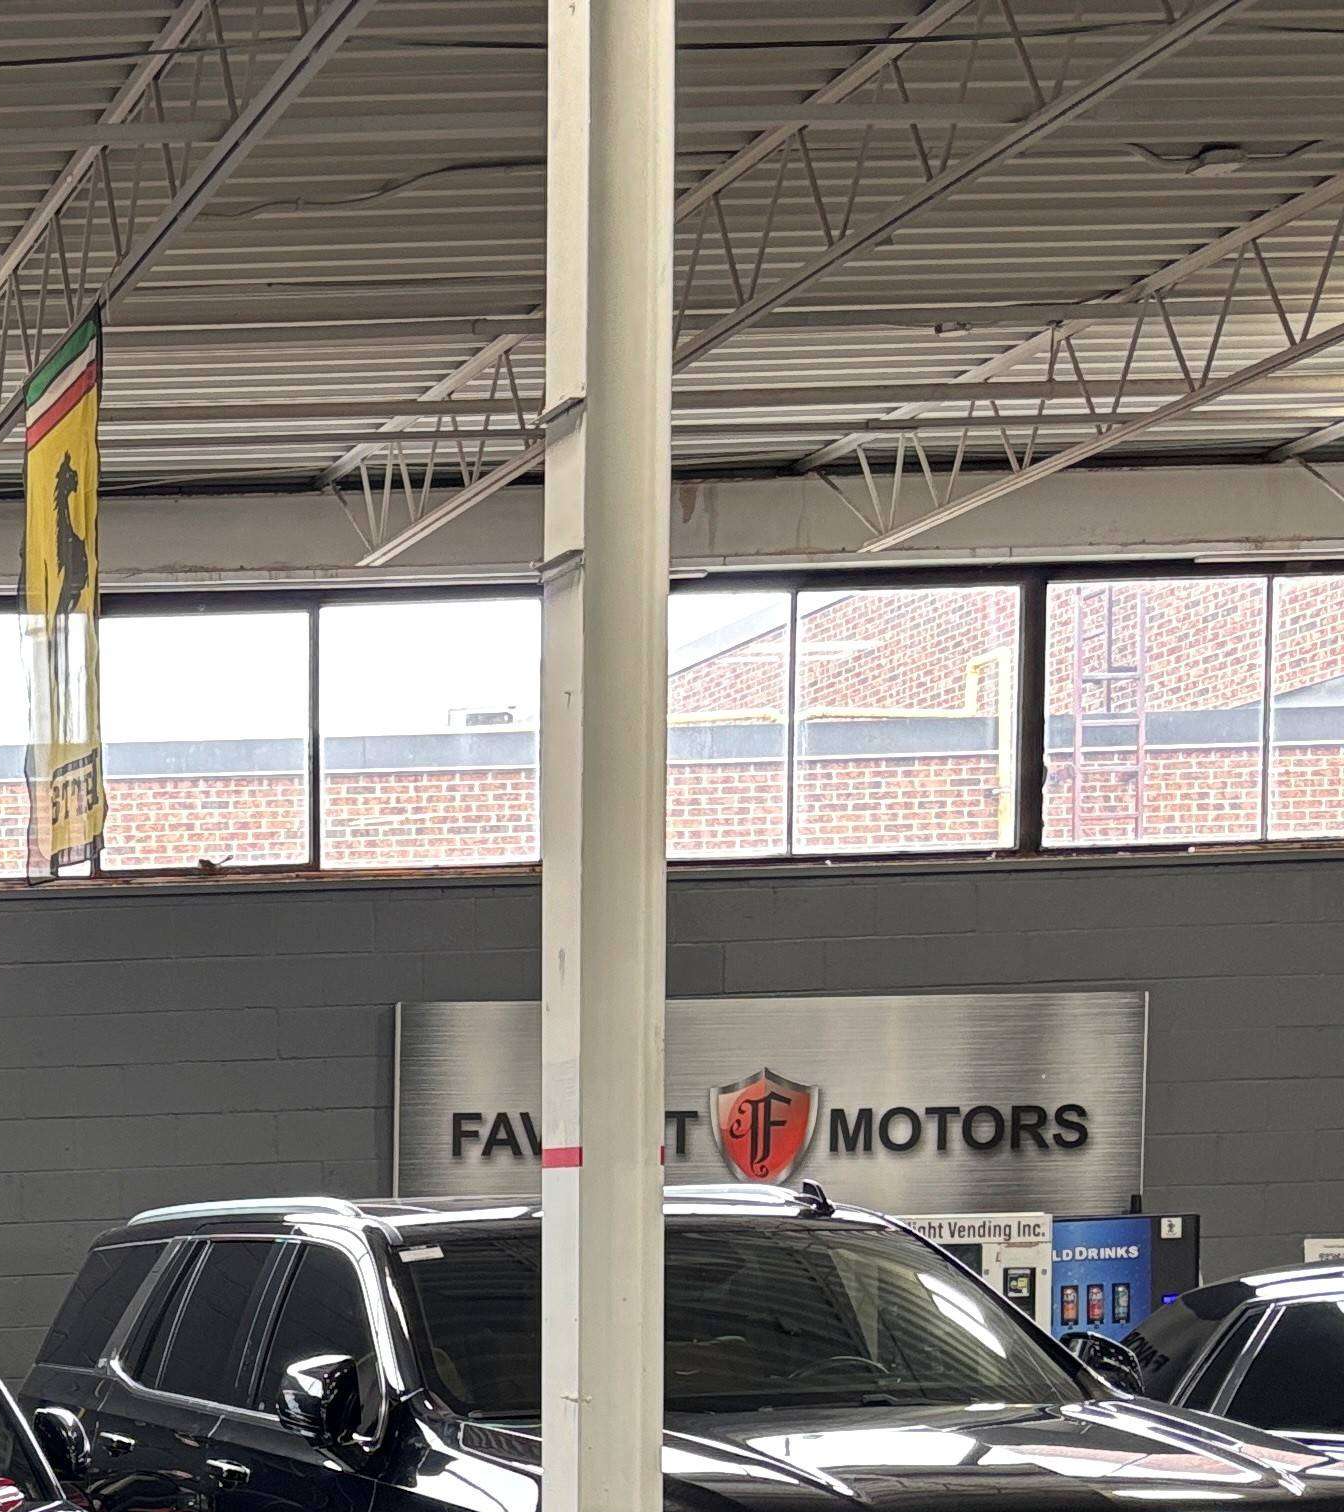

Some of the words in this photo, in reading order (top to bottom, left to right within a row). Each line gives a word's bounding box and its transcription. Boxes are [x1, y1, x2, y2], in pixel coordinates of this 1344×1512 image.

[452, 1110, 698, 1157] FAVT
[829, 1102, 1089, 1153] MOTORS
[948, 1220, 1012, 1242] Vending
[1017, 1220, 1046, 1238] Inc.
[1074, 1245, 1140, 1261] DRINKS
